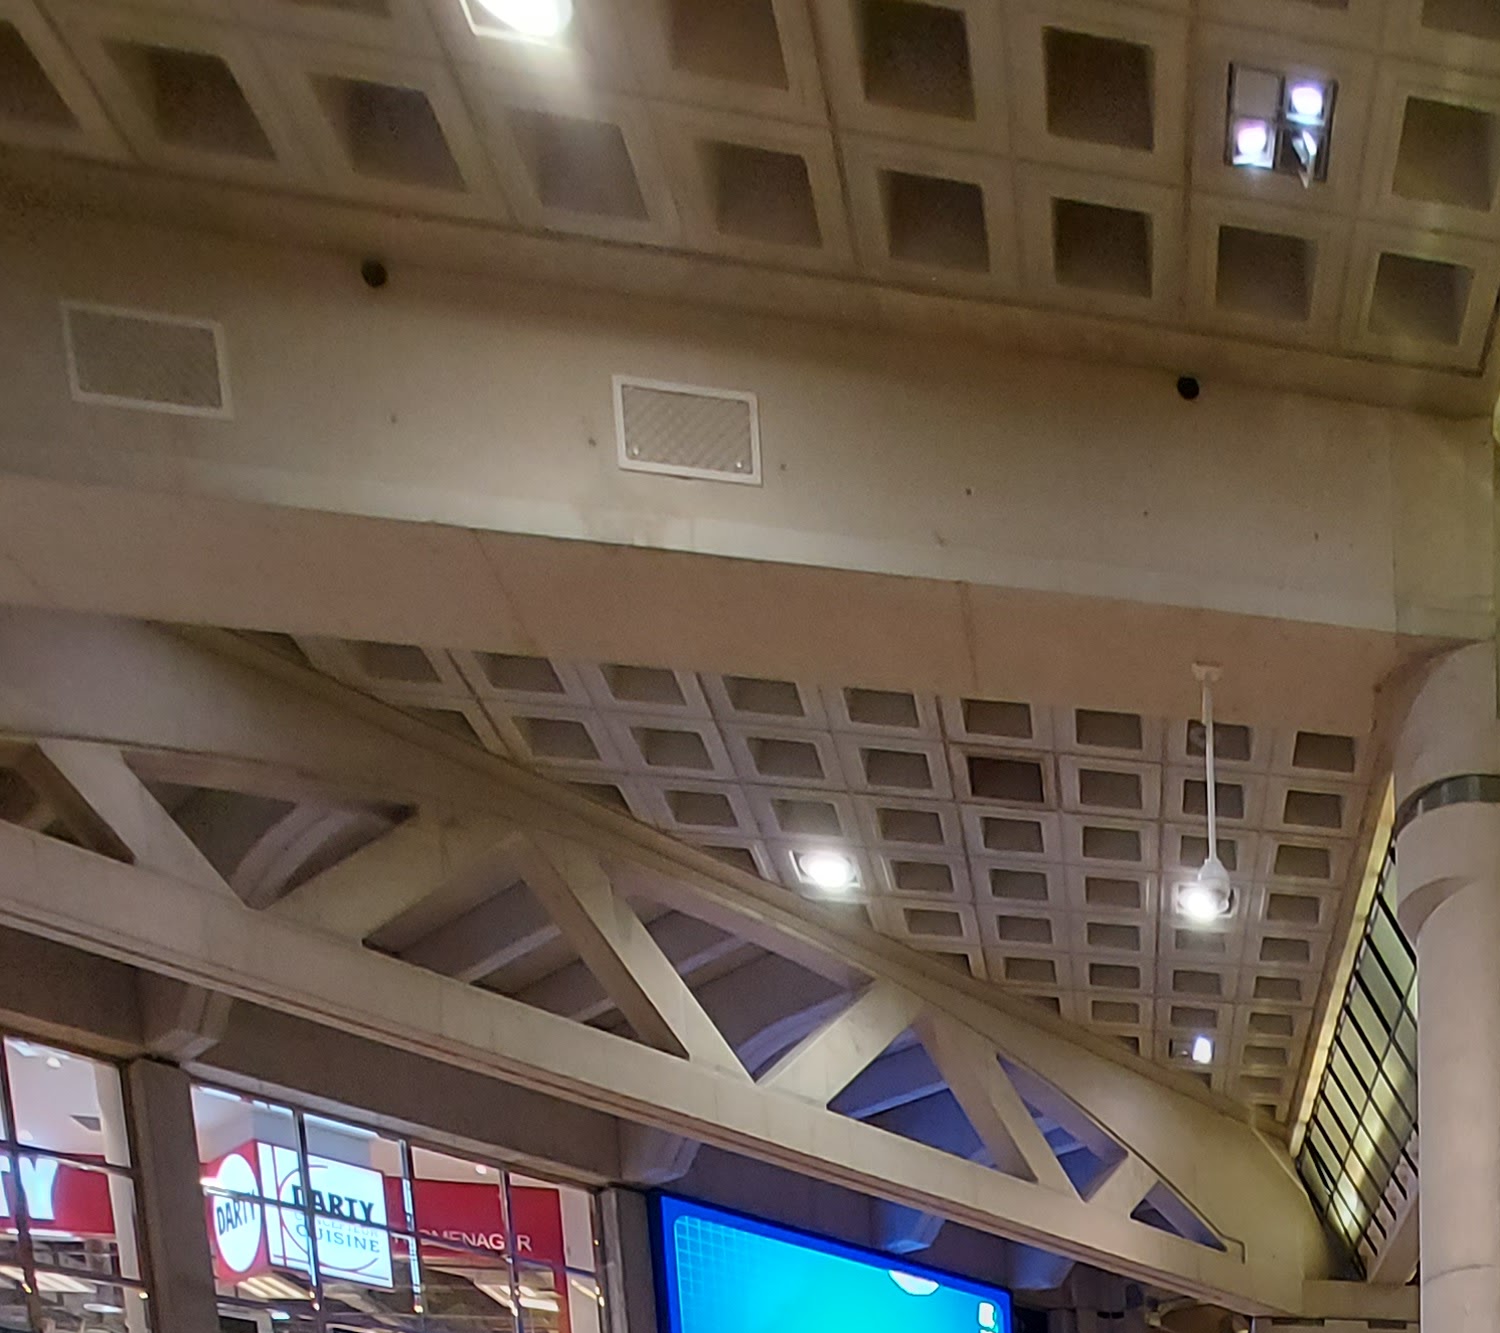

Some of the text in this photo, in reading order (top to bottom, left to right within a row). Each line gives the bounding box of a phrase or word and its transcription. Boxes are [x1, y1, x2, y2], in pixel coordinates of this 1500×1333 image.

[216, 1189, 257, 1236] DARTY
[291, 1184, 374, 1224] DARTY
[295, 1224, 380, 1254] CUISINE
